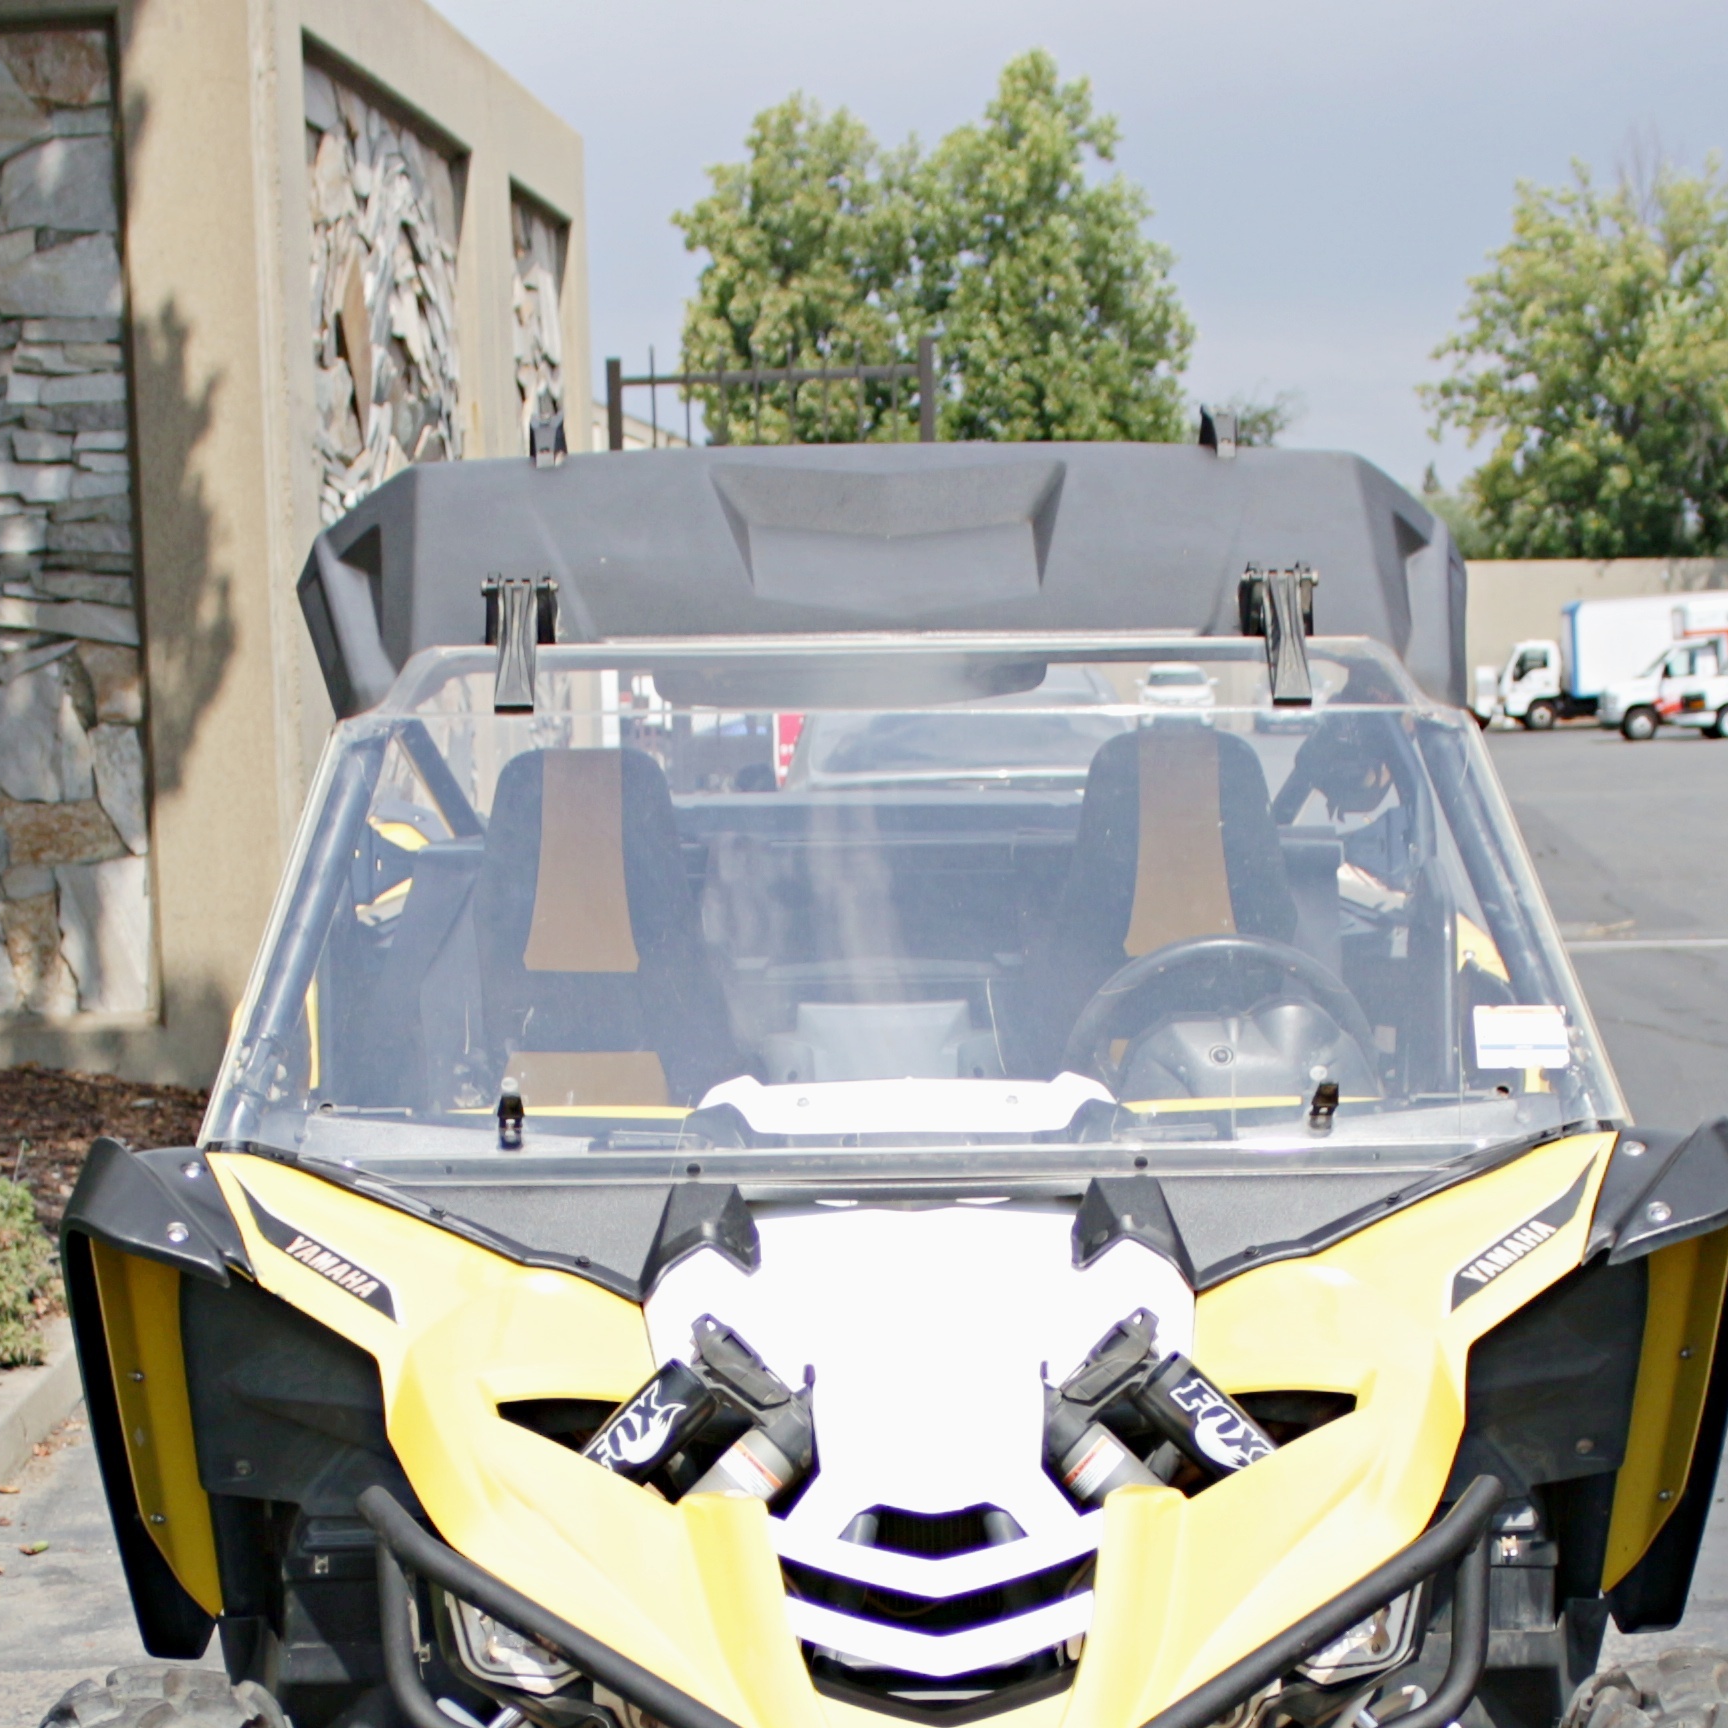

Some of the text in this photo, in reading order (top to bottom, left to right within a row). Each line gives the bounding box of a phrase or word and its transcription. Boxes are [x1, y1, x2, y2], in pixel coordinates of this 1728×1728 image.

[285, 1235, 378, 1298] YAMAHA
[1460, 1220, 1557, 1283] YAMAHA
[581, 1379, 664, 1471] FOX
[1170, 1377, 1275, 1470] FOX
